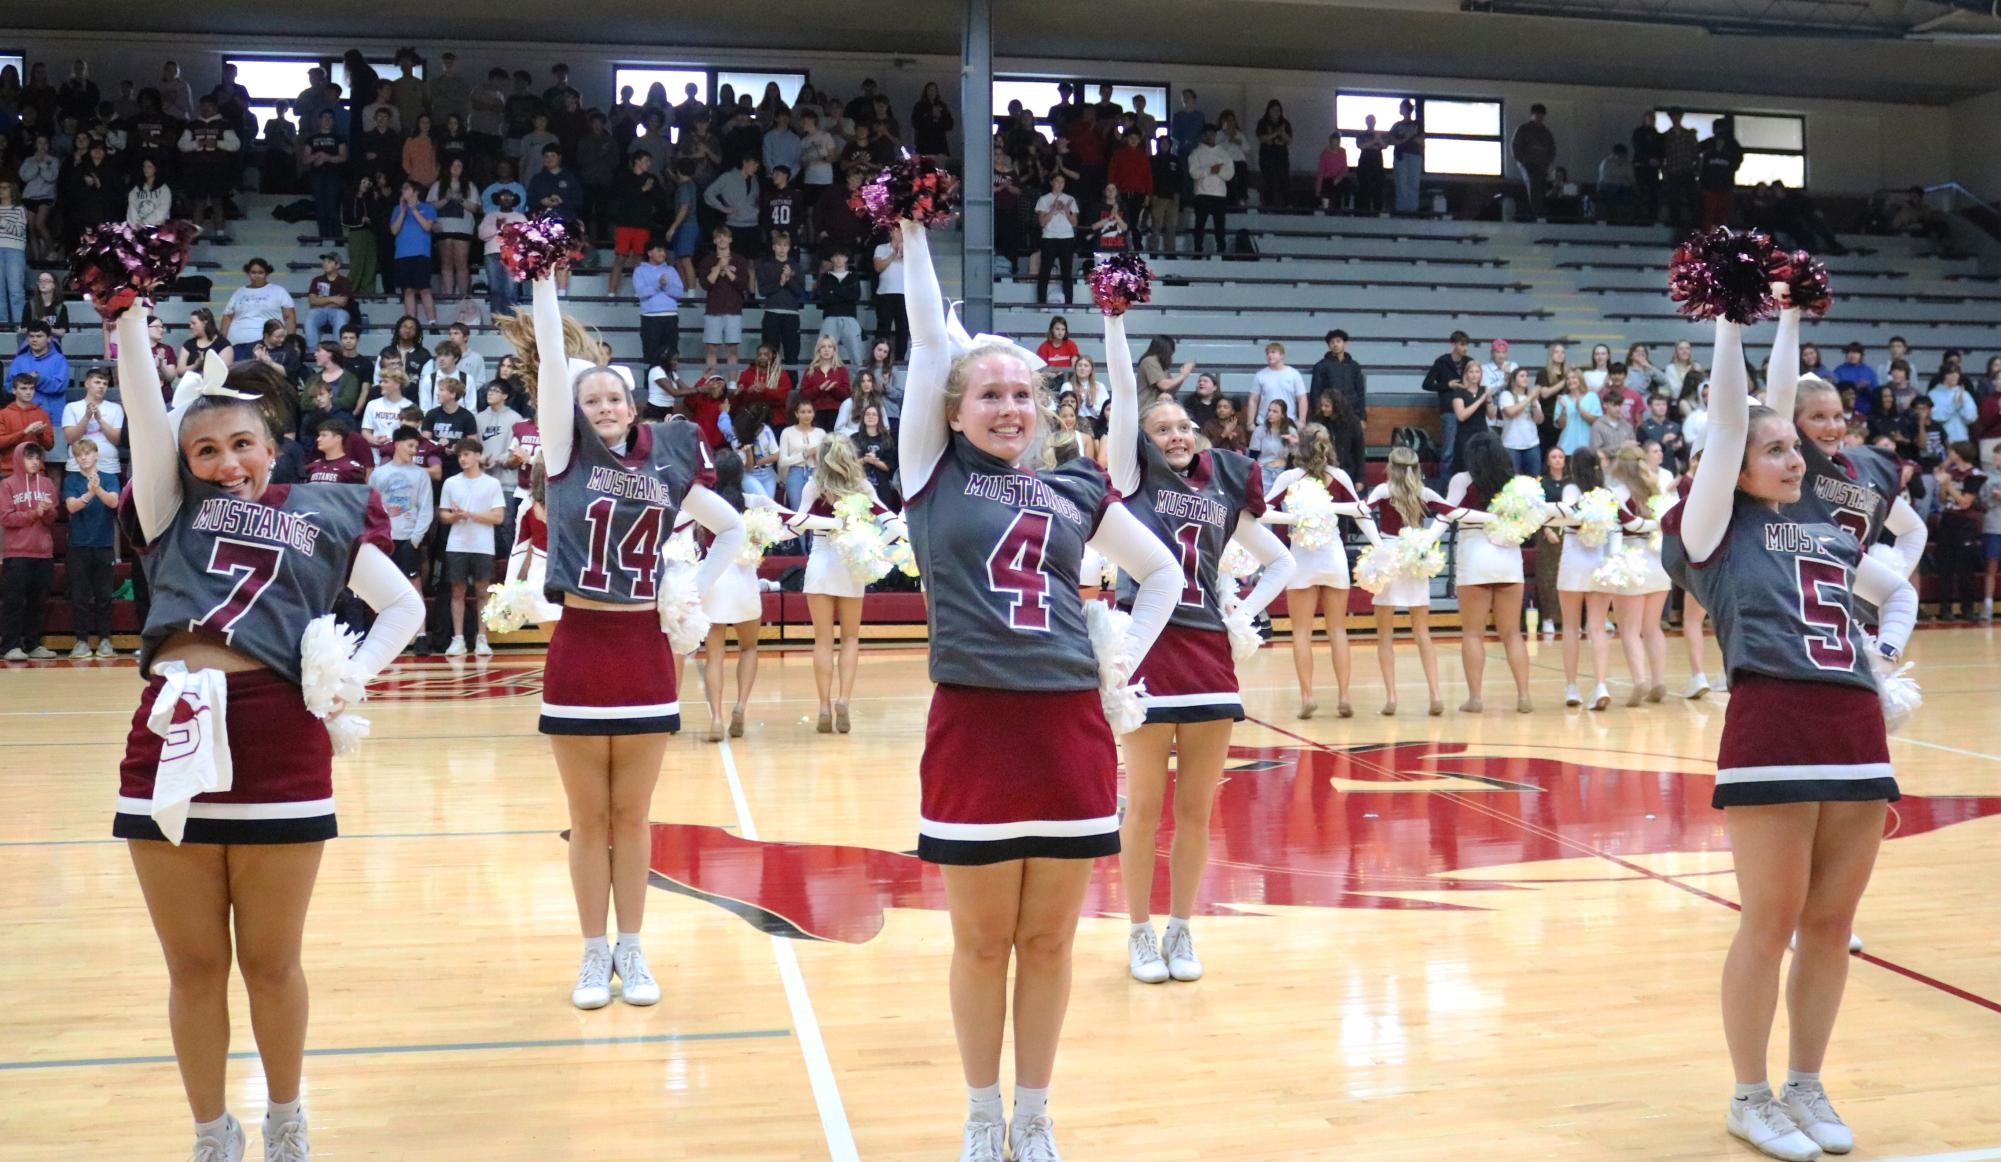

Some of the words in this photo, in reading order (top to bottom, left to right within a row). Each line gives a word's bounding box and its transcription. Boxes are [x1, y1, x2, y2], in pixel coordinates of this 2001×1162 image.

[771, 206, 790, 225] 40
[484, 425, 501, 435] NIKE
[587, 465, 671, 507] MUSTANS
[964, 472, 1082, 525] MUSTANGS
[1155, 489, 1228, 529] MUSTANGS
[192, 498, 321, 557] MUSTANGS
[578, 496, 665, 600] 14
[188, 536, 285, 647] 7
[986, 508, 1052, 632] 4
[1175, 522, 1204, 608] 1
[1795, 556, 1856, 673] 5
